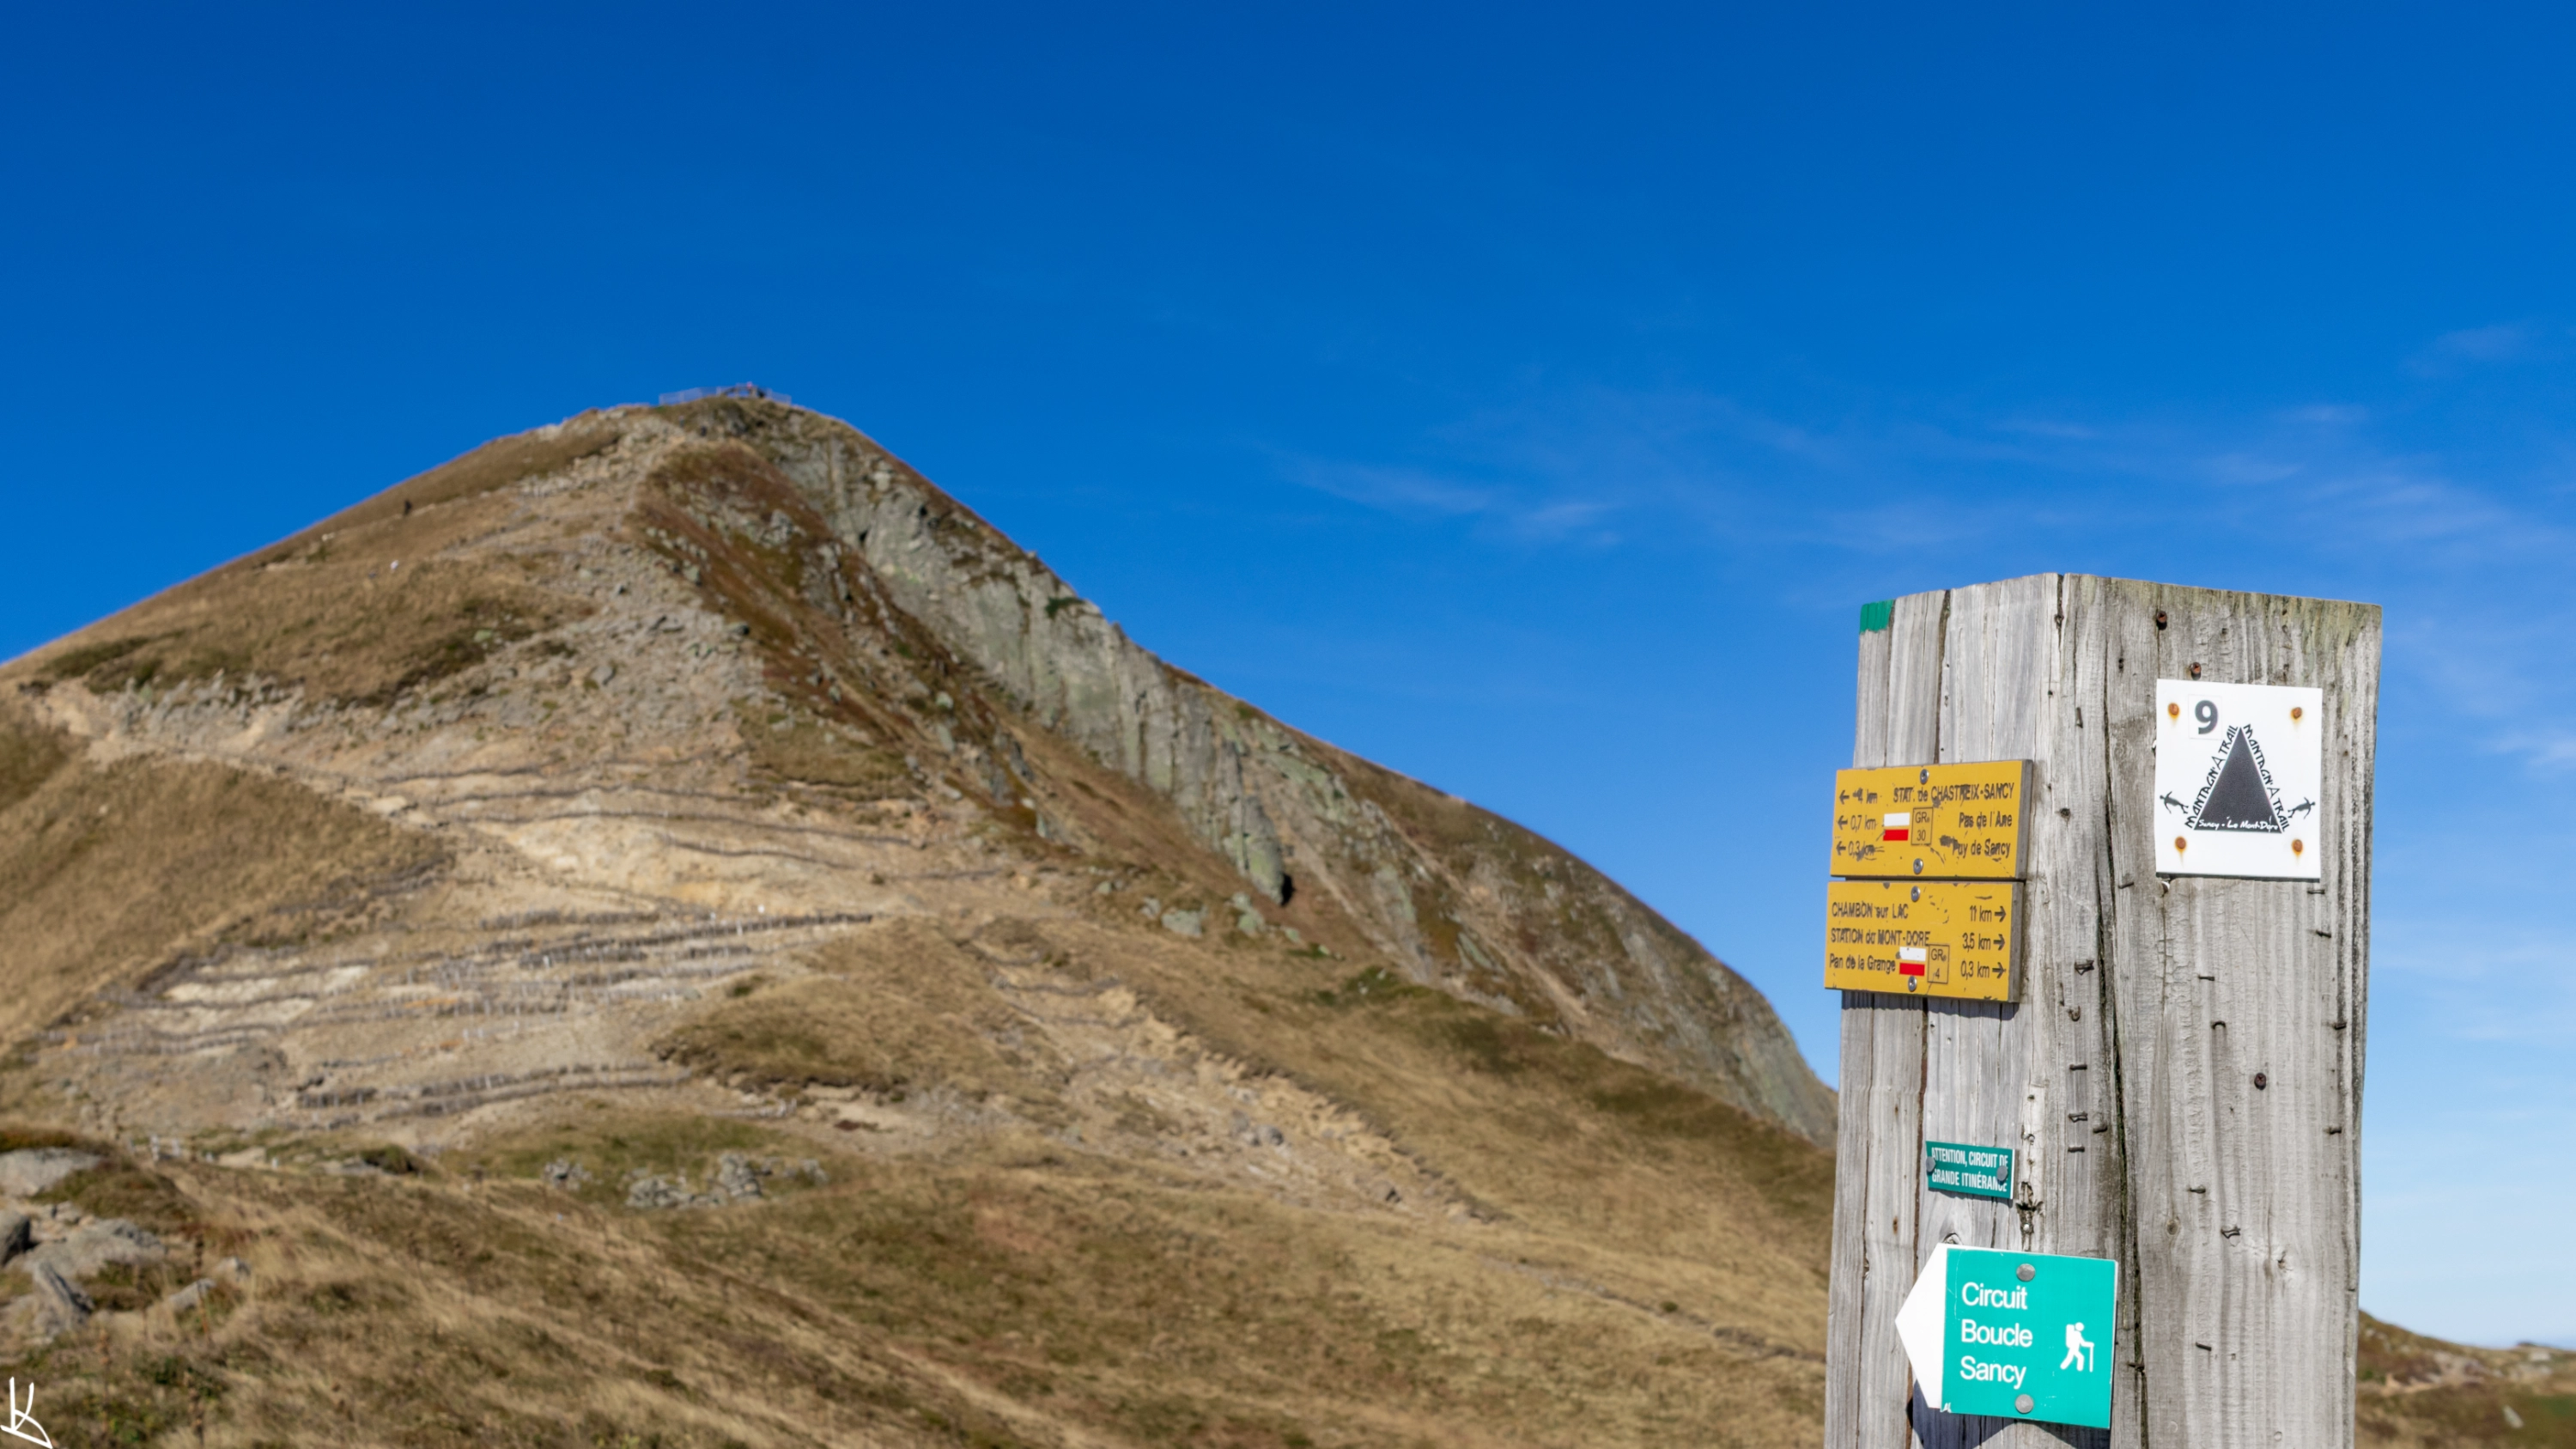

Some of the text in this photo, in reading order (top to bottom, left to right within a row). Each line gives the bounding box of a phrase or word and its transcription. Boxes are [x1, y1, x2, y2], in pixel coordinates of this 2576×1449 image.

[2195, 700, 2219, 734] 9
[2218, 725, 2239, 754] TRAIL
[1866, 788, 1878, 804] km
[1918, 787, 1929, 802] de
[1850, 814, 1876, 832] 0,7 km
[1959, 812, 1973, 828] Pas
[1977, 812, 1987, 828] de
[2273, 798, 2290, 832] TRAIL
[1917, 830, 1927, 842] 30
[1848, 841, 1861, 858] 0,3
[1971, 840, 1982, 856] de
[1984, 838, 2011, 859] Sancy
[1832, 902, 1909, 919] CHAMBON sur LAC
[1970, 904, 1992, 922] 11 km
[1831, 928, 1863, 944] STATION
[1962, 932, 1991, 953] 3,5 km
[1829, 953, 1896, 975] Pan de la Grange
[1935, 968, 1941, 979] 4
[1960, 960, 1990, 980] 0,3 km
[1930, 1147, 2009, 1168] ATTENTION, CIRCUIT DE
[1931, 1168, 1960, 1186] GRANDE
[1962, 1282, 2028, 1310] Circuit
[1961, 1318, 2033, 1348] Boucle
[1959, 1355, 2027, 1390] Sancy
